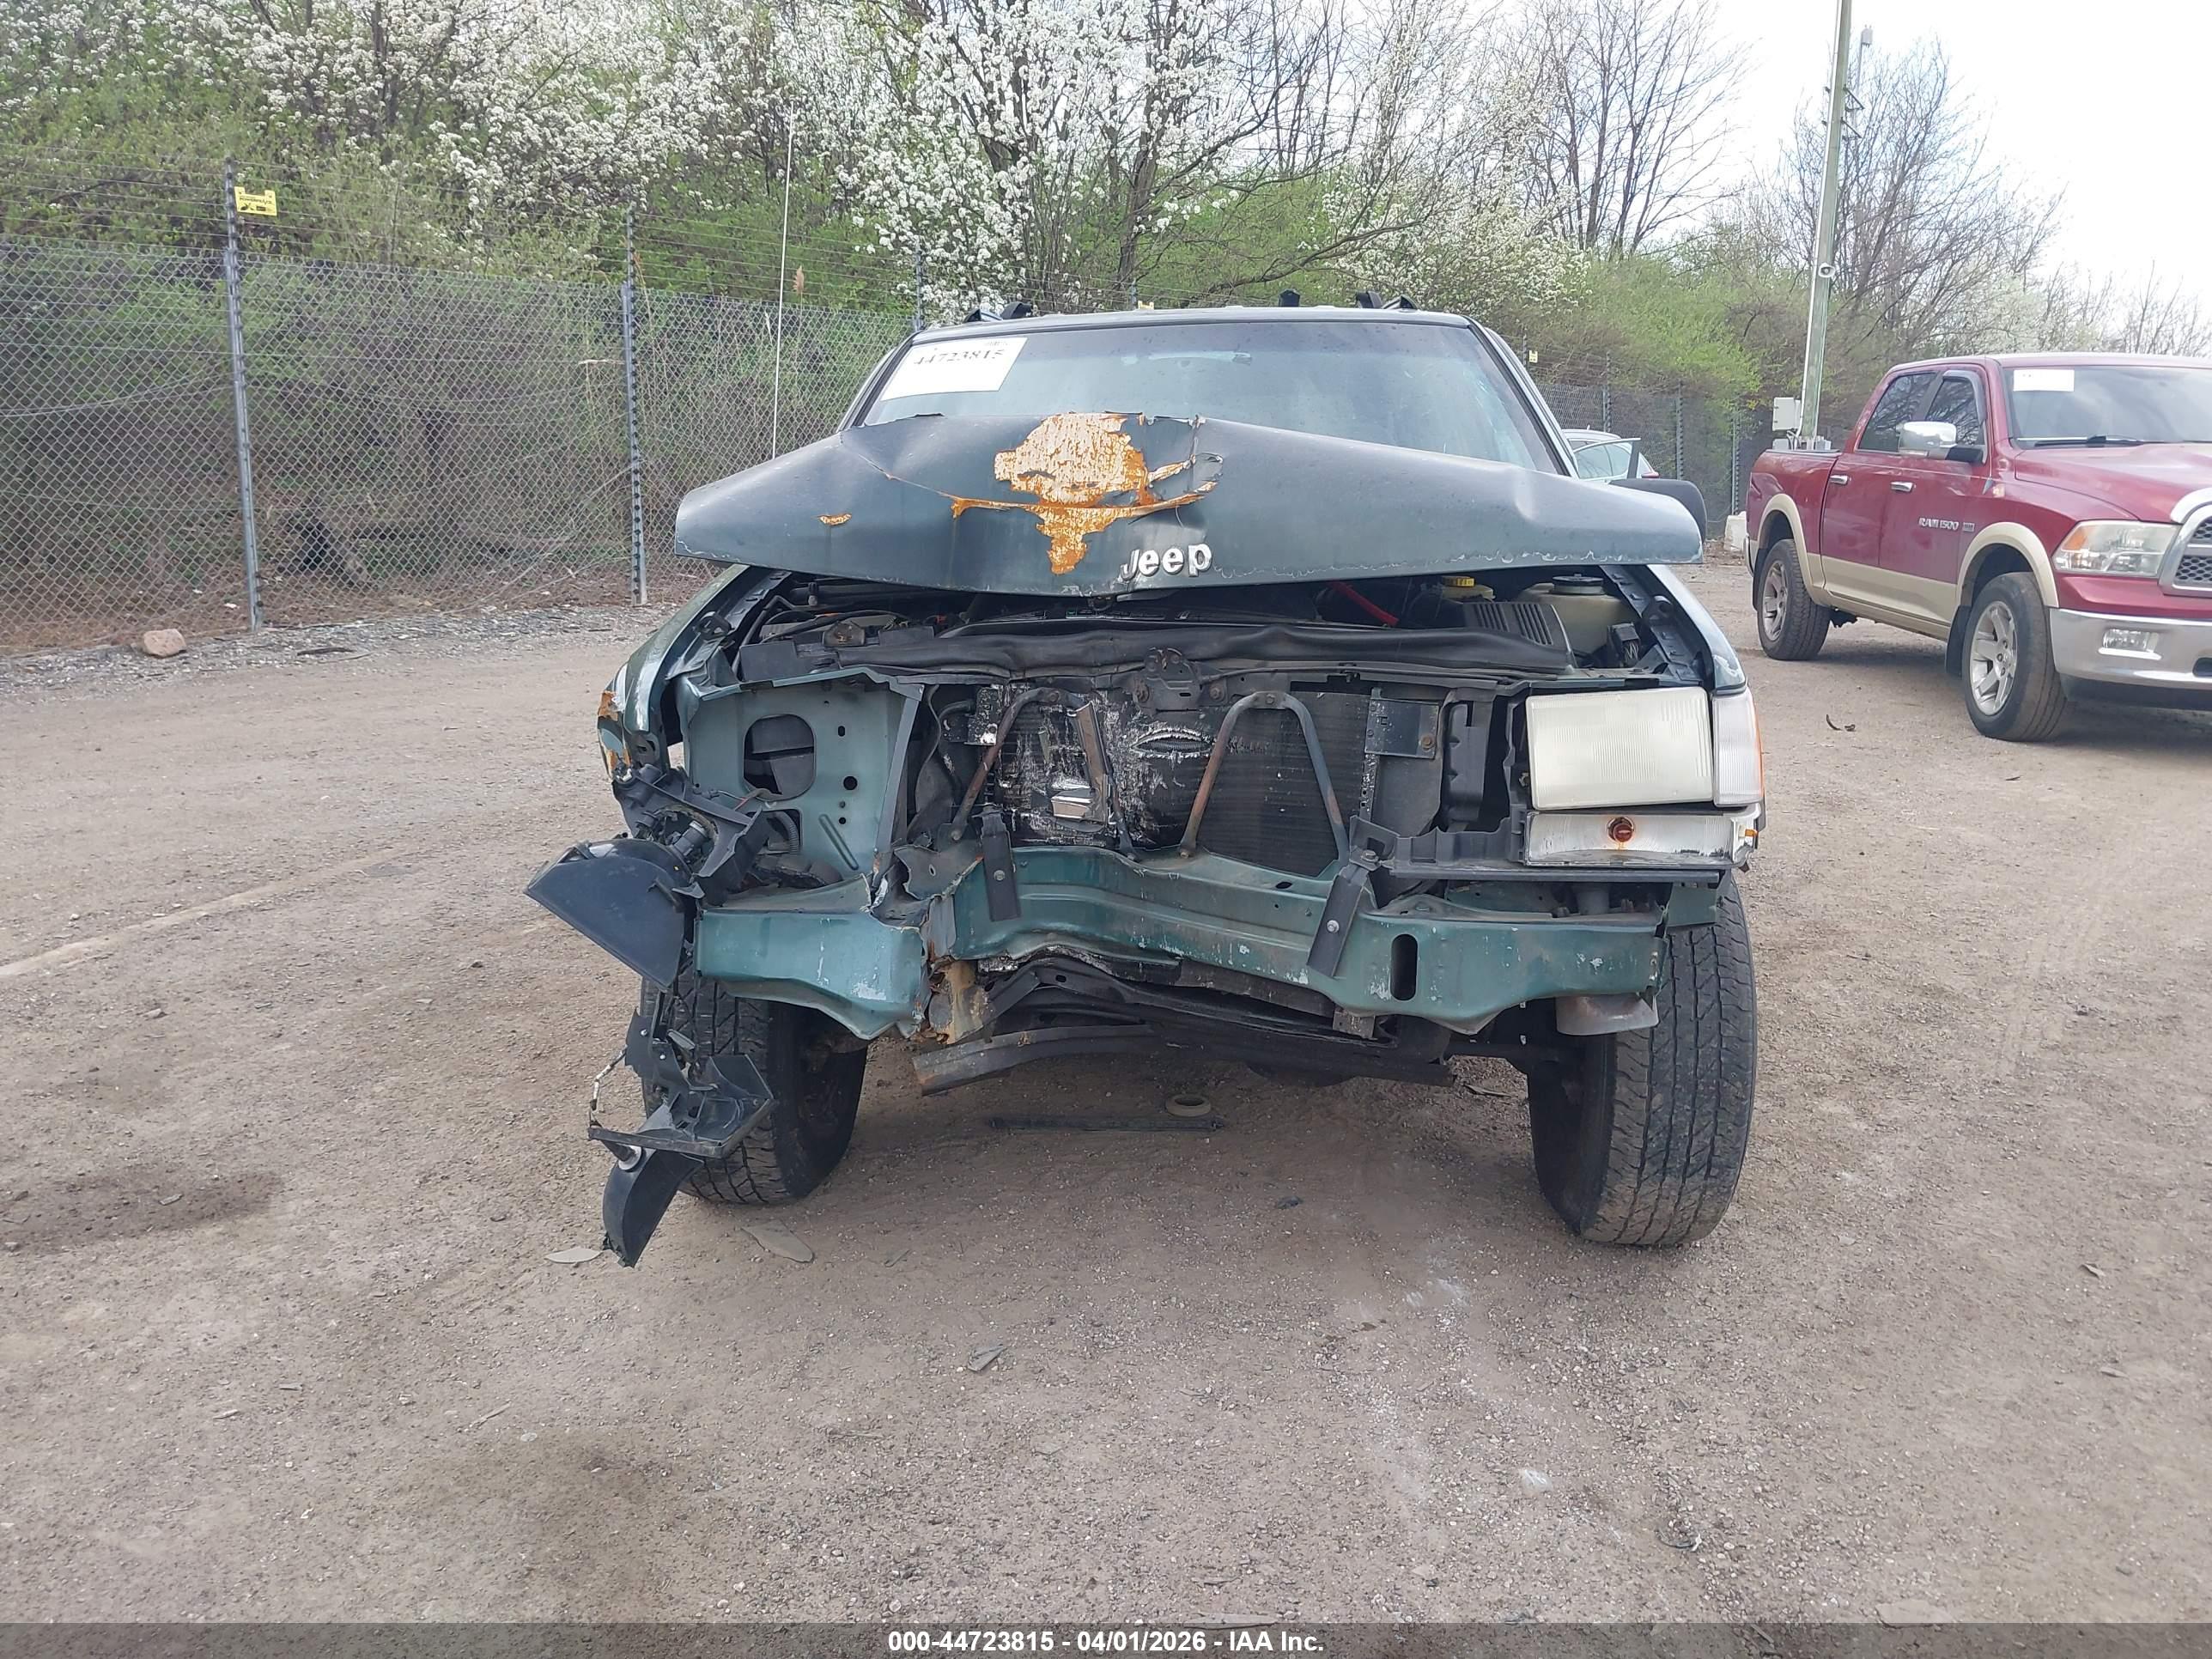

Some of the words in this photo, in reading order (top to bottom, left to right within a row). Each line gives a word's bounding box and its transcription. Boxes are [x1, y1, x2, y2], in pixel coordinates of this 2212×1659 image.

[1917, 517, 1939, 528] RAM
[1940, 520, 1959, 531] 1500
[1120, 543, 1212, 580] Jeep
